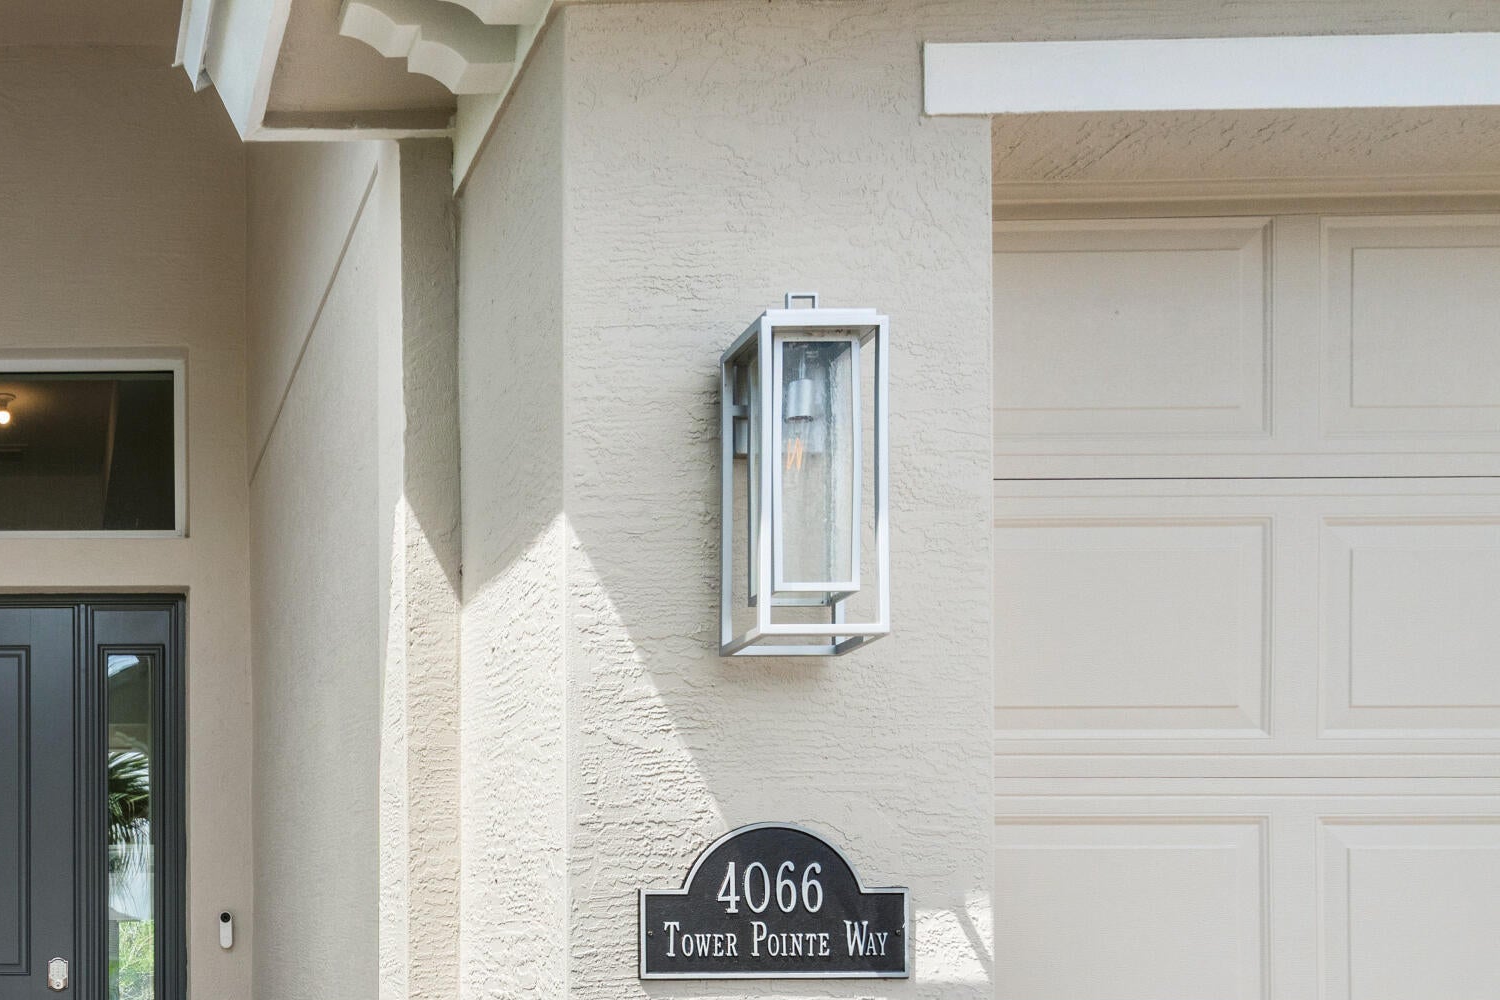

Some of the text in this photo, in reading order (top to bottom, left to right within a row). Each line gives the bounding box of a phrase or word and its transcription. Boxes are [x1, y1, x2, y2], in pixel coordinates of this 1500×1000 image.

[717, 861, 823, 913] 4066
[663, 919, 888, 957] TOWER POINTE WAY
